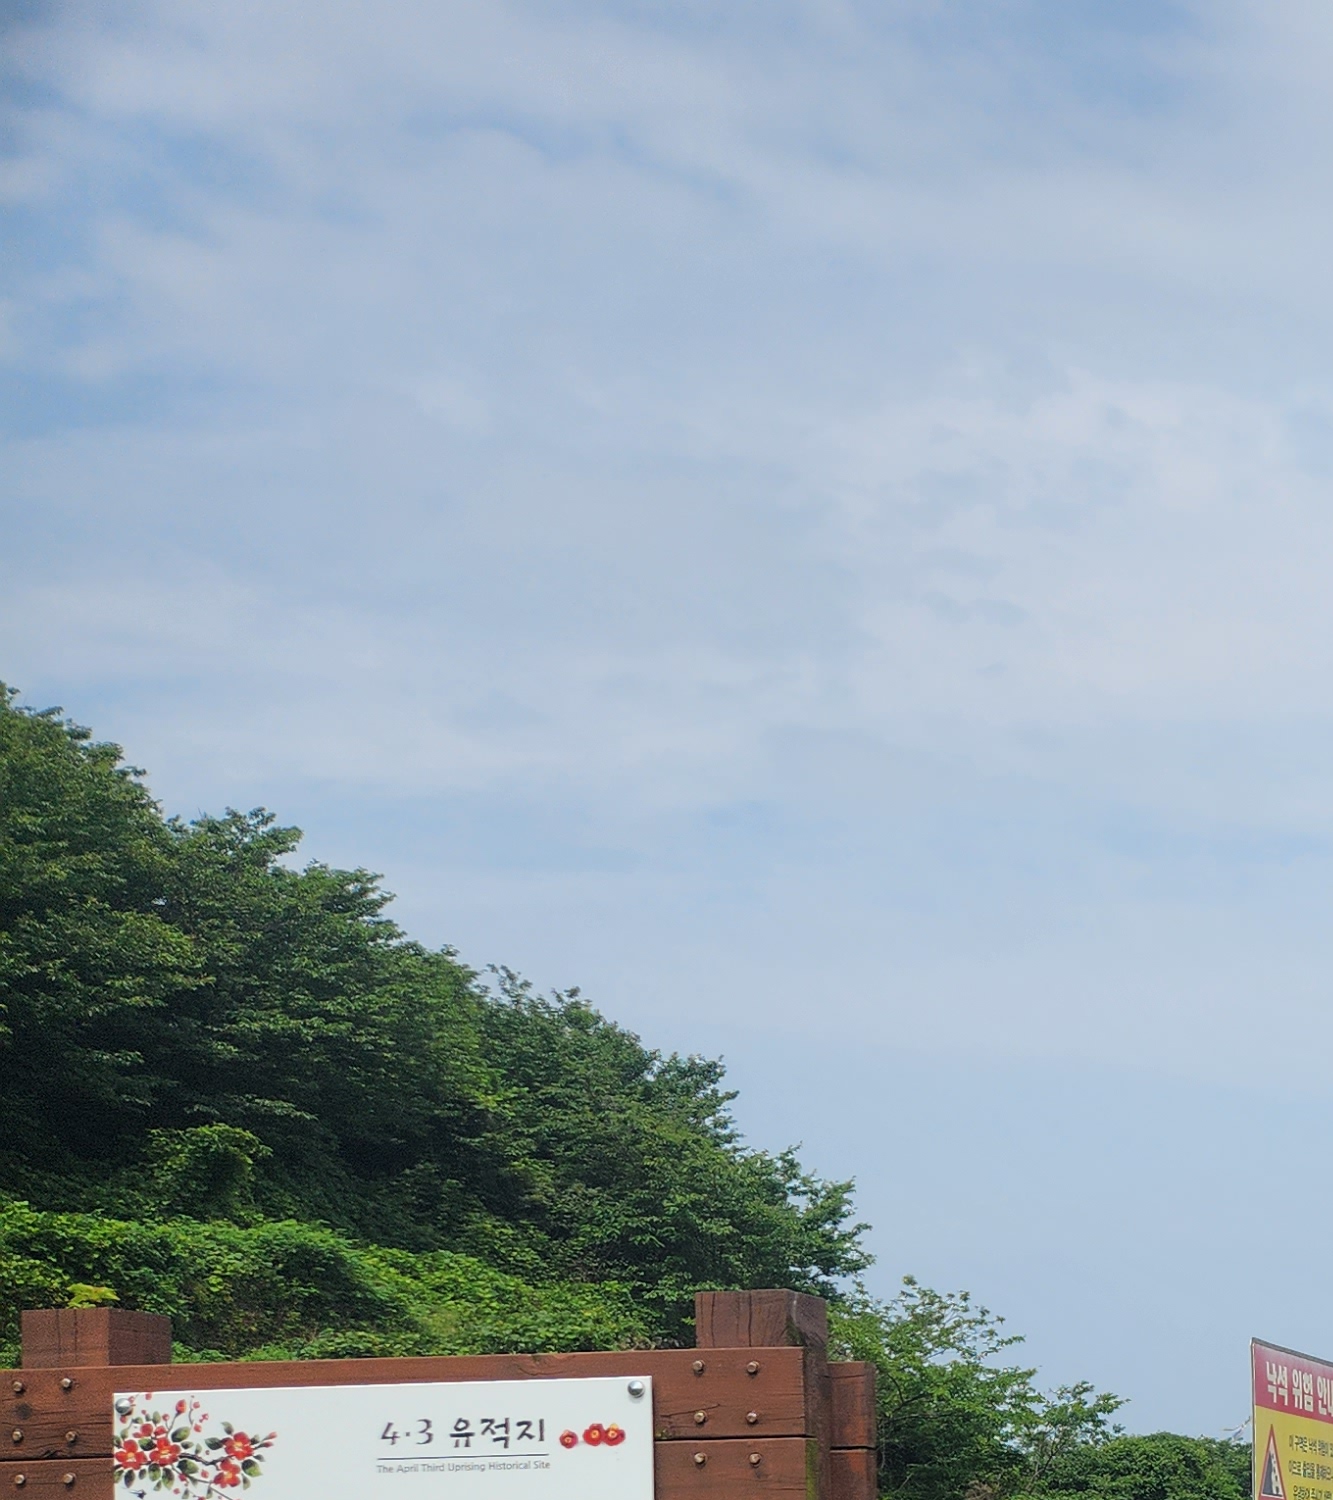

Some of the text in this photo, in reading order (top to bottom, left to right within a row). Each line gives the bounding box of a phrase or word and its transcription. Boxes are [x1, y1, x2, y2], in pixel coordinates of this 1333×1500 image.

[1266, 1360, 1288, 1406] 낙석
[1292, 1368, 1313, 1412] 위험
[379, 1414, 545, 1451] 4·3 유적지
[376, 1460, 550, 1473] The April Third Uprising Historical Site
